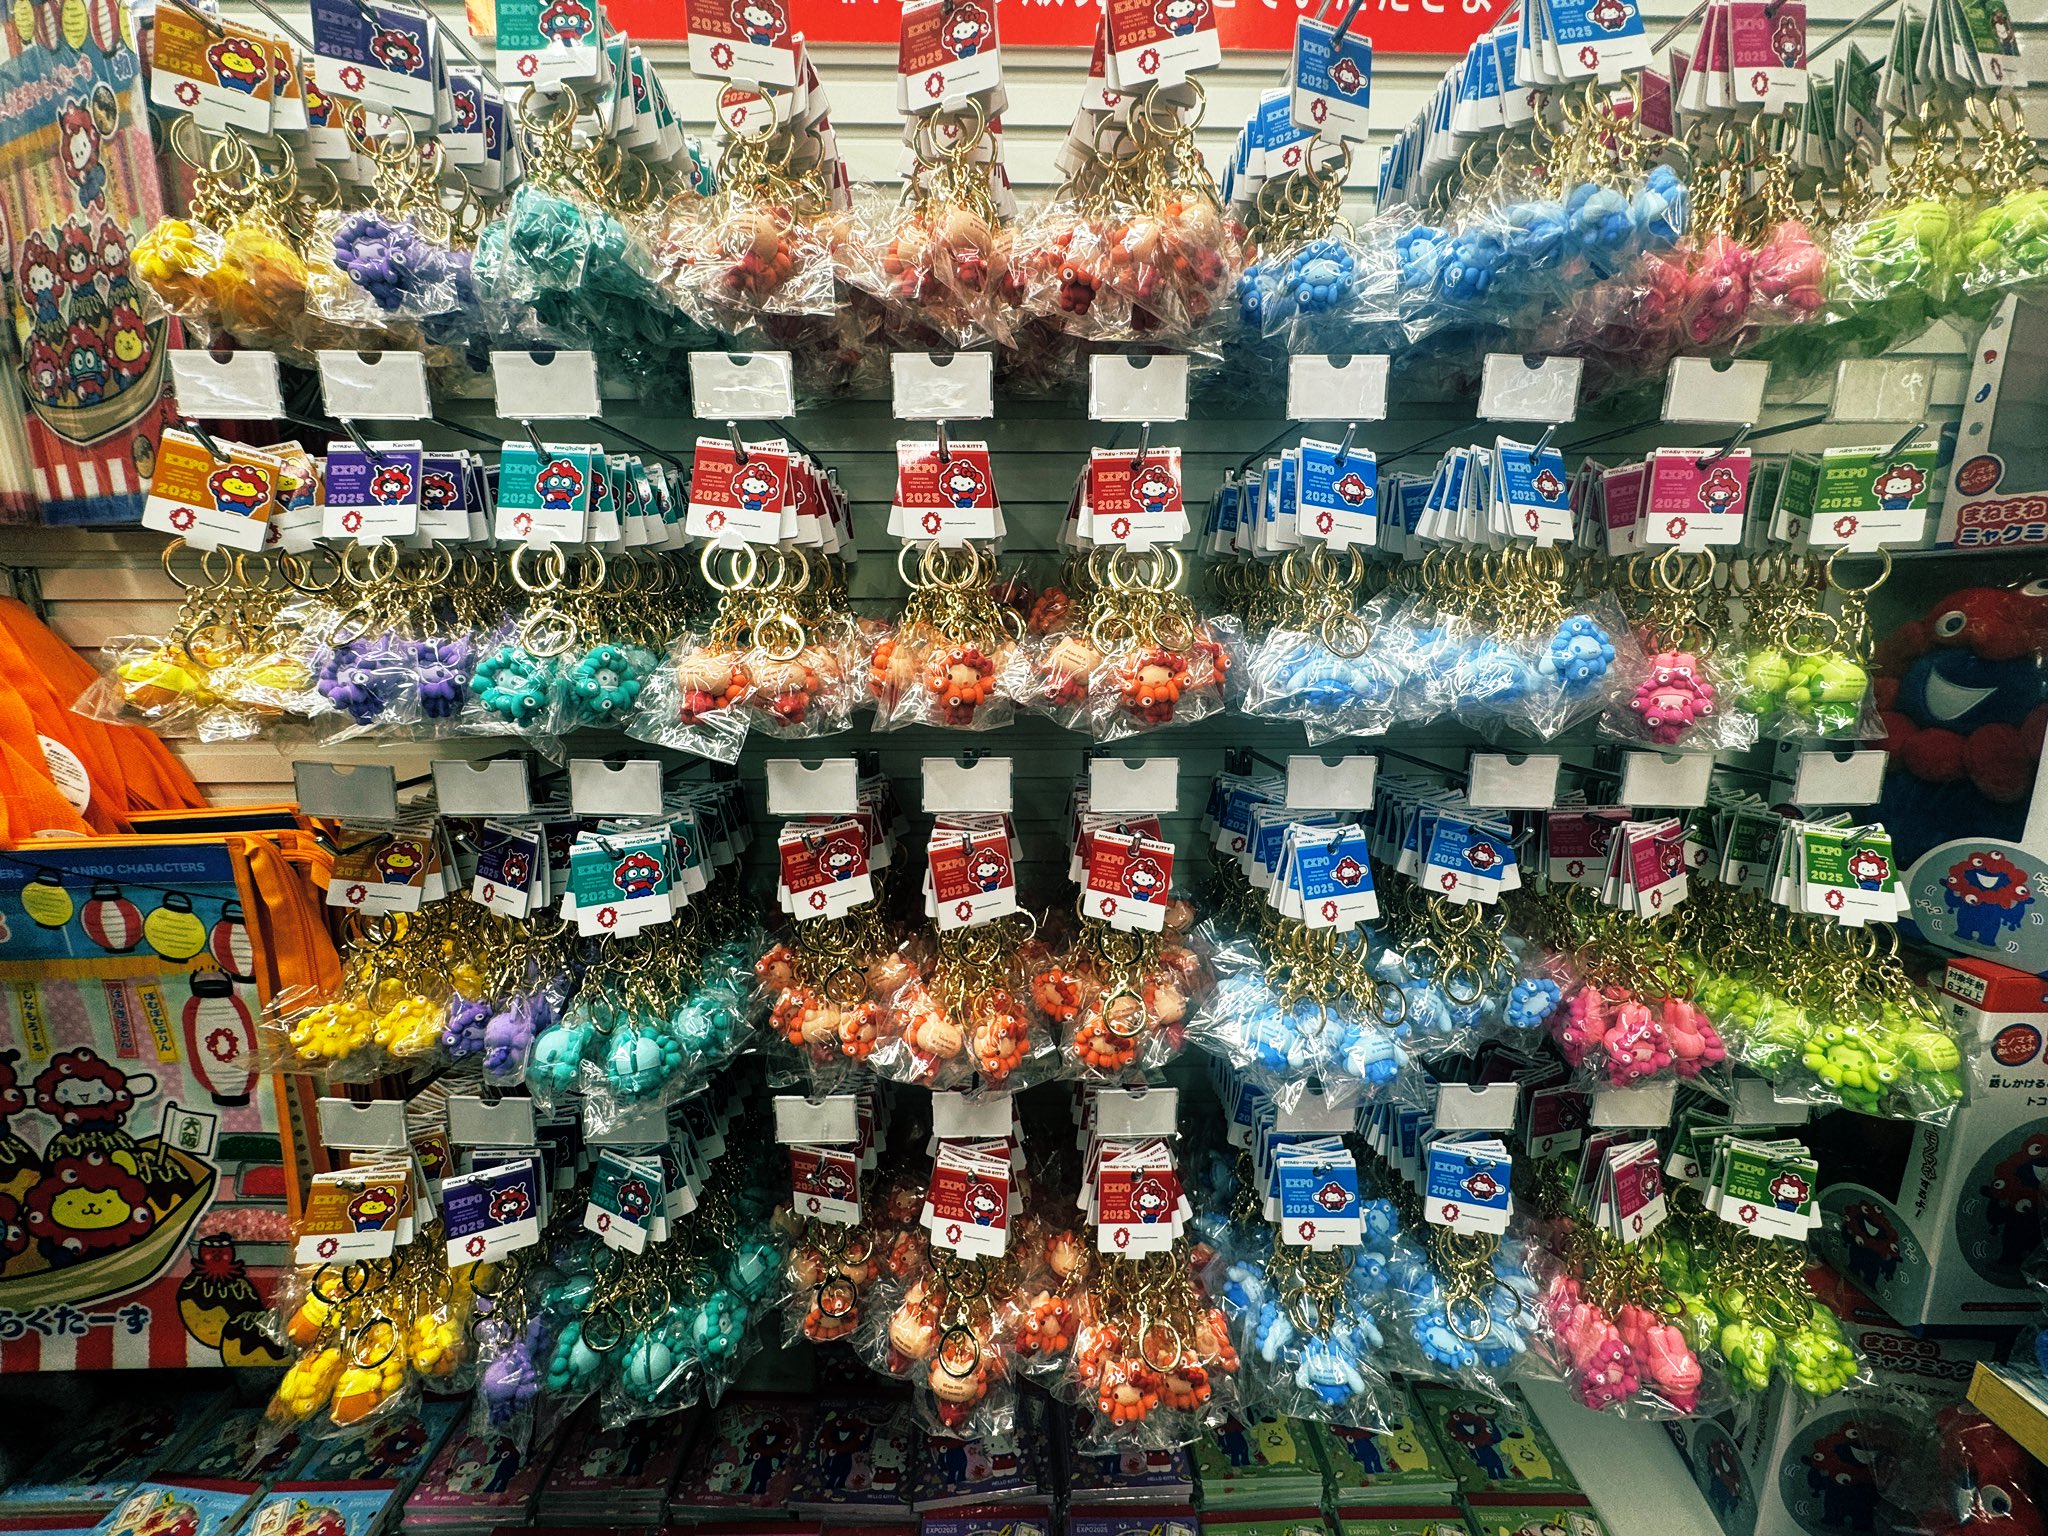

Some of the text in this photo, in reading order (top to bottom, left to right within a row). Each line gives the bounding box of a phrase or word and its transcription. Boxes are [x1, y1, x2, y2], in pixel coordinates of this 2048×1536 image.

[500, 4, 537, 16] EXPO
[318, 9, 362, 30] EXPO
[691, 16, 732, 34] 2025
[1735, 18, 1765, 30] EXPO
[908, 18, 940, 37] EXPO
[1559, 25, 1593, 40] 2025
[501, 35, 540, 46] 2025
[1118, 27, 1157, 46] 2025
[319, 41, 364, 60] 2025
[1303, 39, 1330, 58] EXPO
[909, 49, 943, 70] 2025
[1736, 52, 1768, 62] 2025
[158, 53, 203, 76] 2025
[1301, 72, 1329, 91] 2025
[1266, 105, 1290, 123] EXP
[1268, 129, 1300, 147] 2025
[165, 453, 209, 472] EXPO
[505, 464, 537, 474] EXPO
[699, 460, 734, 473] EXPO
[904, 464, 937, 473] EXPO
[1307, 461, 1334, 475] EXPO
[1507, 462, 1531, 473] EXPO
[331, 465, 366, 475] EXPO
[1659, 470, 1694, 480] EXPO
[1826, 468, 1867, 479] EXPO
[1098, 472, 1130, 482] EXPO
[157, 482, 203, 501] 2025
[695, 489, 729, 502] 2025
[906, 493, 940, 503] 2025
[1305, 490, 1334, 504] 2025
[1511, 490, 1536, 502] 2025
[1610, 485, 1638, 498] EXP
[329, 494, 365, 503] 2025
[502, 493, 535, 504] 2025
[1098, 500, 1131, 510] 2025
[1655, 498, 1690, 509] 2025
[1821, 497, 1862, 509] 2025
[1613, 513, 1636, 524] 202
[1963, 501, 2046, 523] まねまね
[1228, 819, 1247, 831] 202
[1440, 830, 1467, 843] EXPO
[1636, 848, 1655, 861] EXPO
[1810, 845, 1842, 856] EXPO
[936, 858, 966, 871] EXPO
[1096, 852, 1125, 865] EXPO
[1303, 857, 1330, 868] EXPO
[1434, 853, 1462, 866] 2025
[61, 862, 206, 877] SANRIO CHARACTERS
[336, 867, 371, 878] 2025
[478, 865, 499, 878] 2025
[577, 863, 612, 875] EXPO
[792, 874, 822, 889] 2025
[1639, 874, 1659, 887] 2025
[1811, 870, 1843, 883] 2025
[941, 884, 970, 898] 2025
[1091, 878, 1120, 891] 2025
[1307, 883, 1334, 895] 2025
[580, 889, 615, 903] 2025
[1947, 981, 1982, 1001] 6才以上
[1999, 1035, 2035, 1047] モノマネ
[1996, 1044, 2036, 1056] ぬいぐるみ
[1989, 1079, 2048, 1088] 話しかける
[182, 1118, 200, 1148] 大阪
[505, 1162, 527, 1171] Kuromi
[1434, 1161, 1464, 1174] EXPO
[1734, 1161, 1765, 1176] EXPO
[795, 1182, 820, 1192] 2025
[939, 1179, 966, 1191] EXPO
[1104, 1183, 1130, 1192] EXPO
[1285, 1179, 1313, 1188] EXPO
[1431, 1185, 1462, 1198] 2025
[1729, 1184, 1762, 1199] 2025
[313, 1195, 348, 1205] EXPO
[449, 1194, 482, 1210] EXPO
[937, 1205, 964, 1217] 2025
[1103, 1210, 1130, 1219] 2025
[1286, 1205, 1315, 1214] 2025
[307, 1221, 342, 1231] 2025
[450, 1219, 484, 1237] 2025
[1863, 1335, 1935, 1355] まねまね
[1867, 1351, 1974, 1378] ミャクミャク
[1076, 1526, 1108, 1534] EXPO2025
